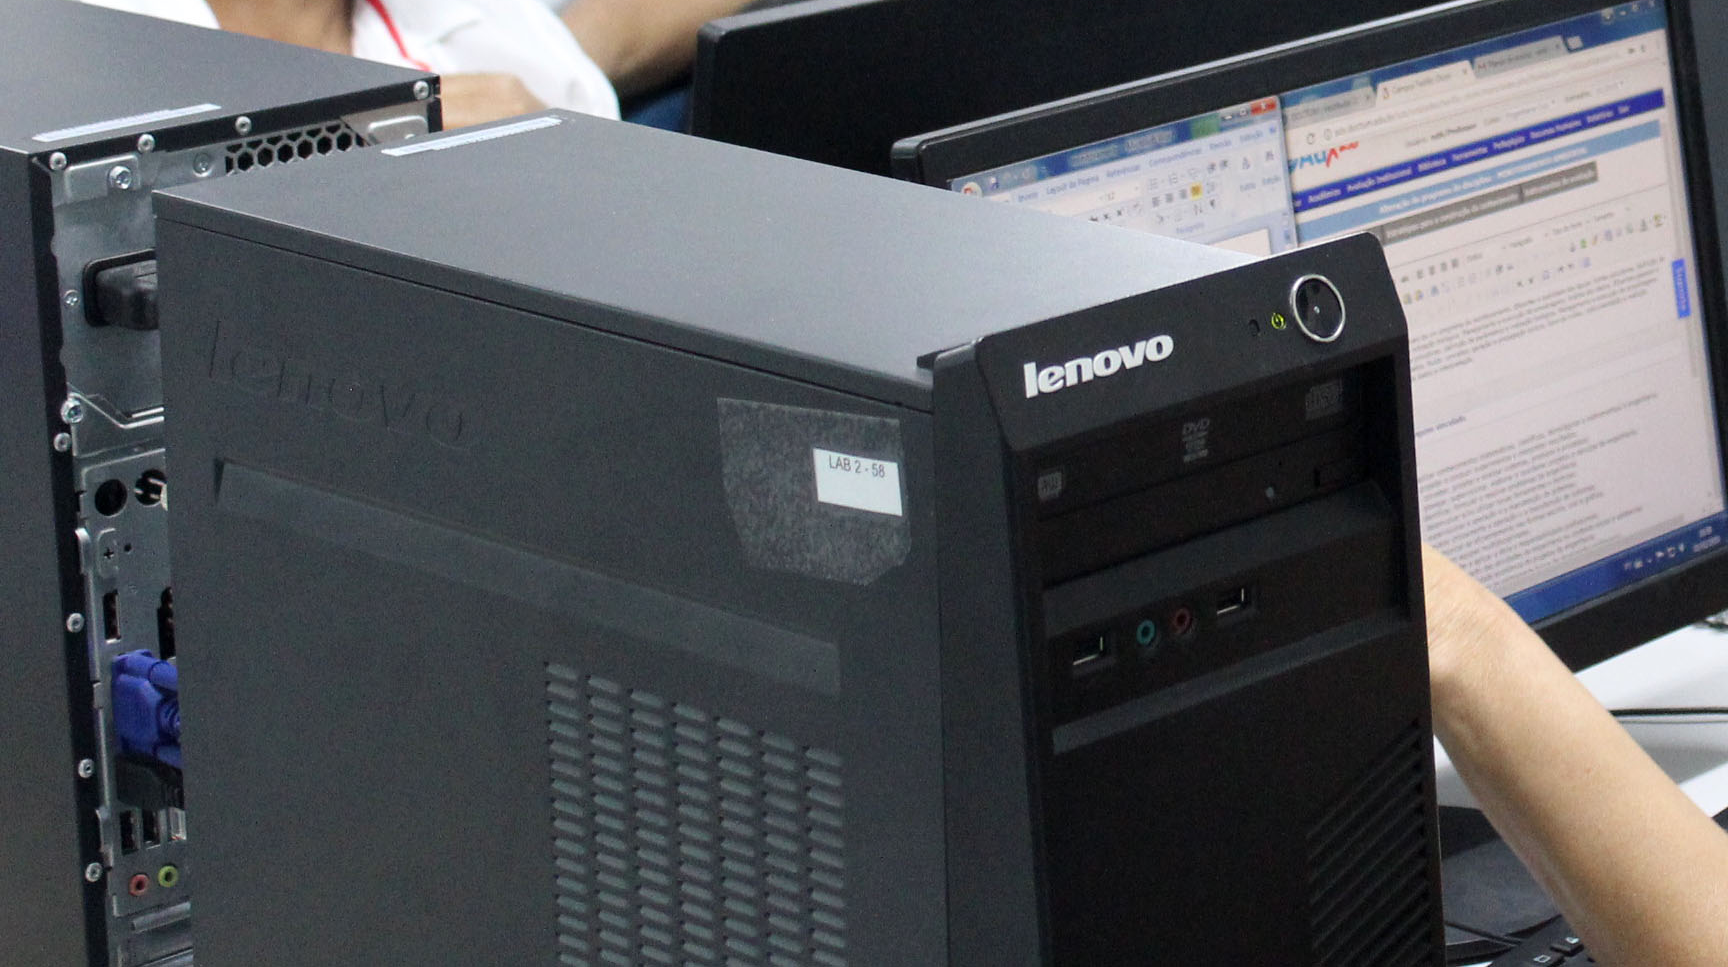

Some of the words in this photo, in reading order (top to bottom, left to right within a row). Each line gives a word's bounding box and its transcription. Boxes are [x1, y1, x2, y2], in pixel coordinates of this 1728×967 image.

[1023, 334, 1175, 400] lenovo
[1182, 416, 1211, 435] DVD
[828, 454, 852, 472] LAB
[854, 459, 862, 474] 2
[871, 462, 886, 479] 58
